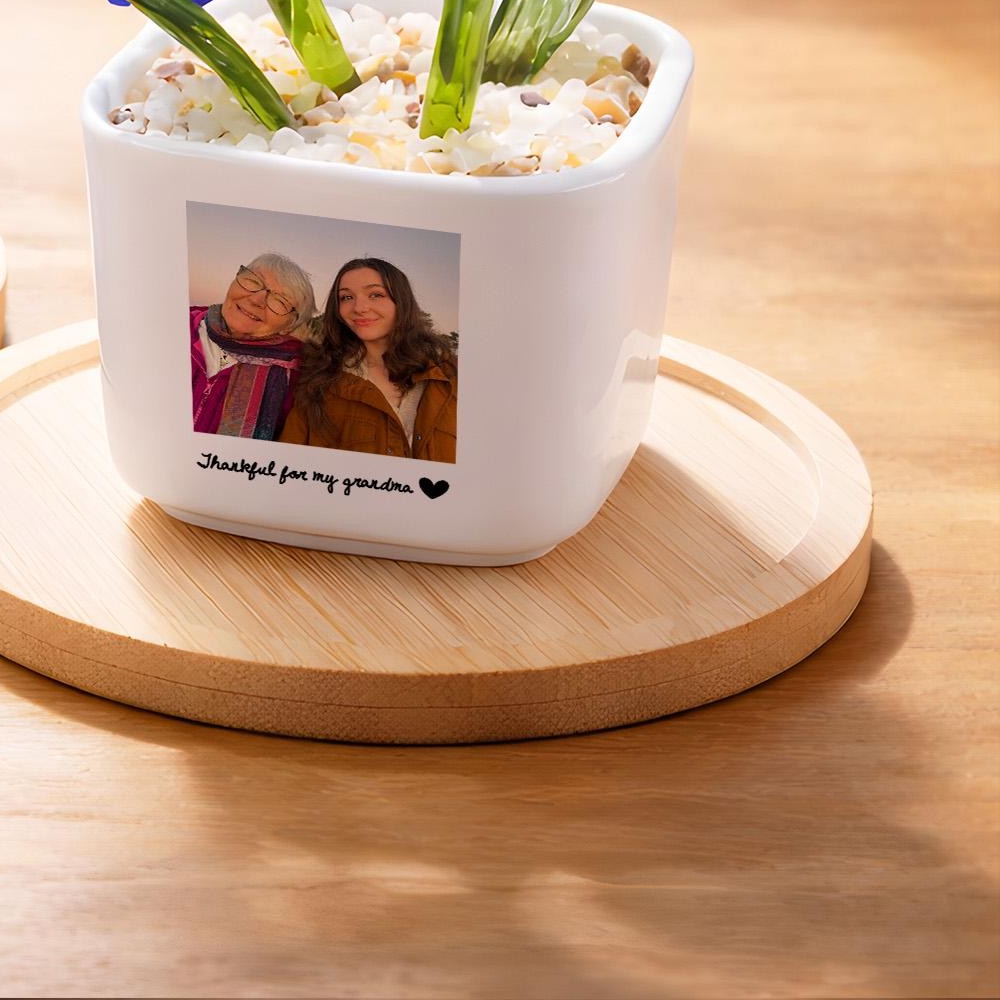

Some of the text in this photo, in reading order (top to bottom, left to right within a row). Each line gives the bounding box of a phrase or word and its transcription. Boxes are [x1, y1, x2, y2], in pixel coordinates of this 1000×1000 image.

[196, 452, 415, 497] Thankful for my grandma
